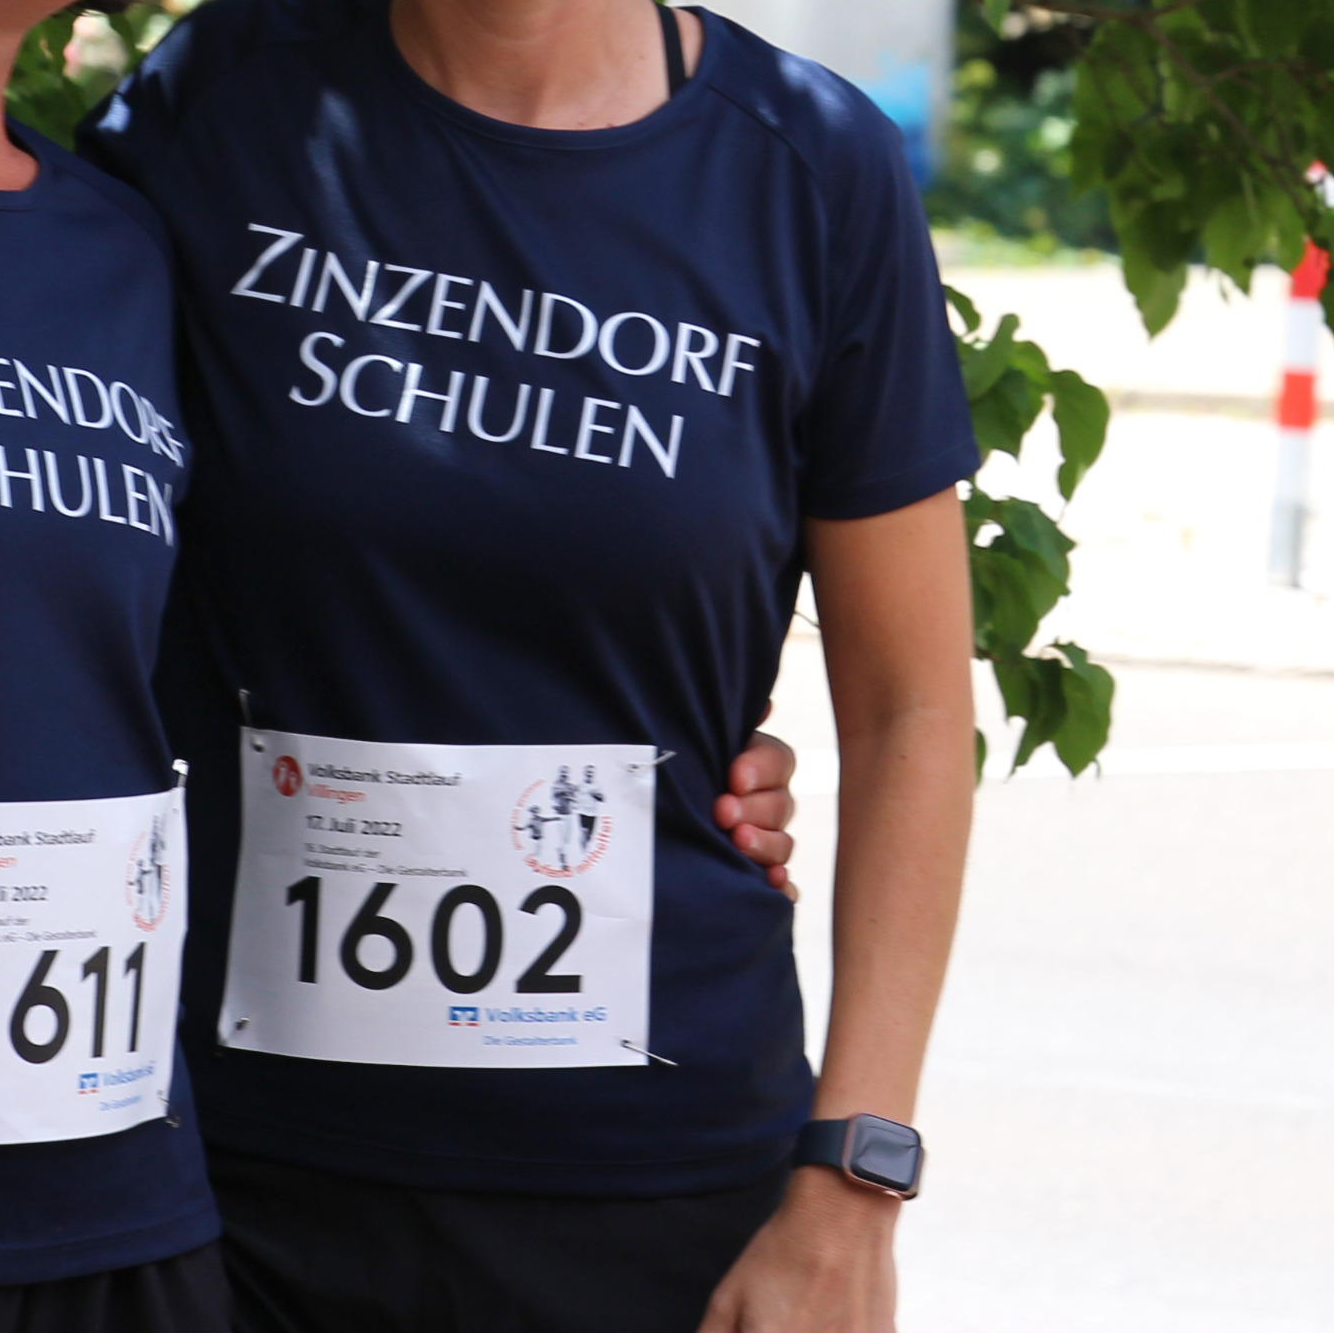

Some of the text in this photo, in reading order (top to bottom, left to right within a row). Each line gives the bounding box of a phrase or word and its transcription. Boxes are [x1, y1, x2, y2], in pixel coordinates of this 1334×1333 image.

[231, 223, 761, 398] ZINZENDORF
[288, 331, 684, 479] SCHULEN
[307, 763, 463, 786] Volksbank Stadtlauf
[34, 828, 97, 845] Stadtlauf
[305, 815, 403, 837] 17. Juli 2022
[11, 885, 49, 902] 2022
[285, 875, 583, 995] 1602
[484, 1006, 608, 1023] Volksbank eG
